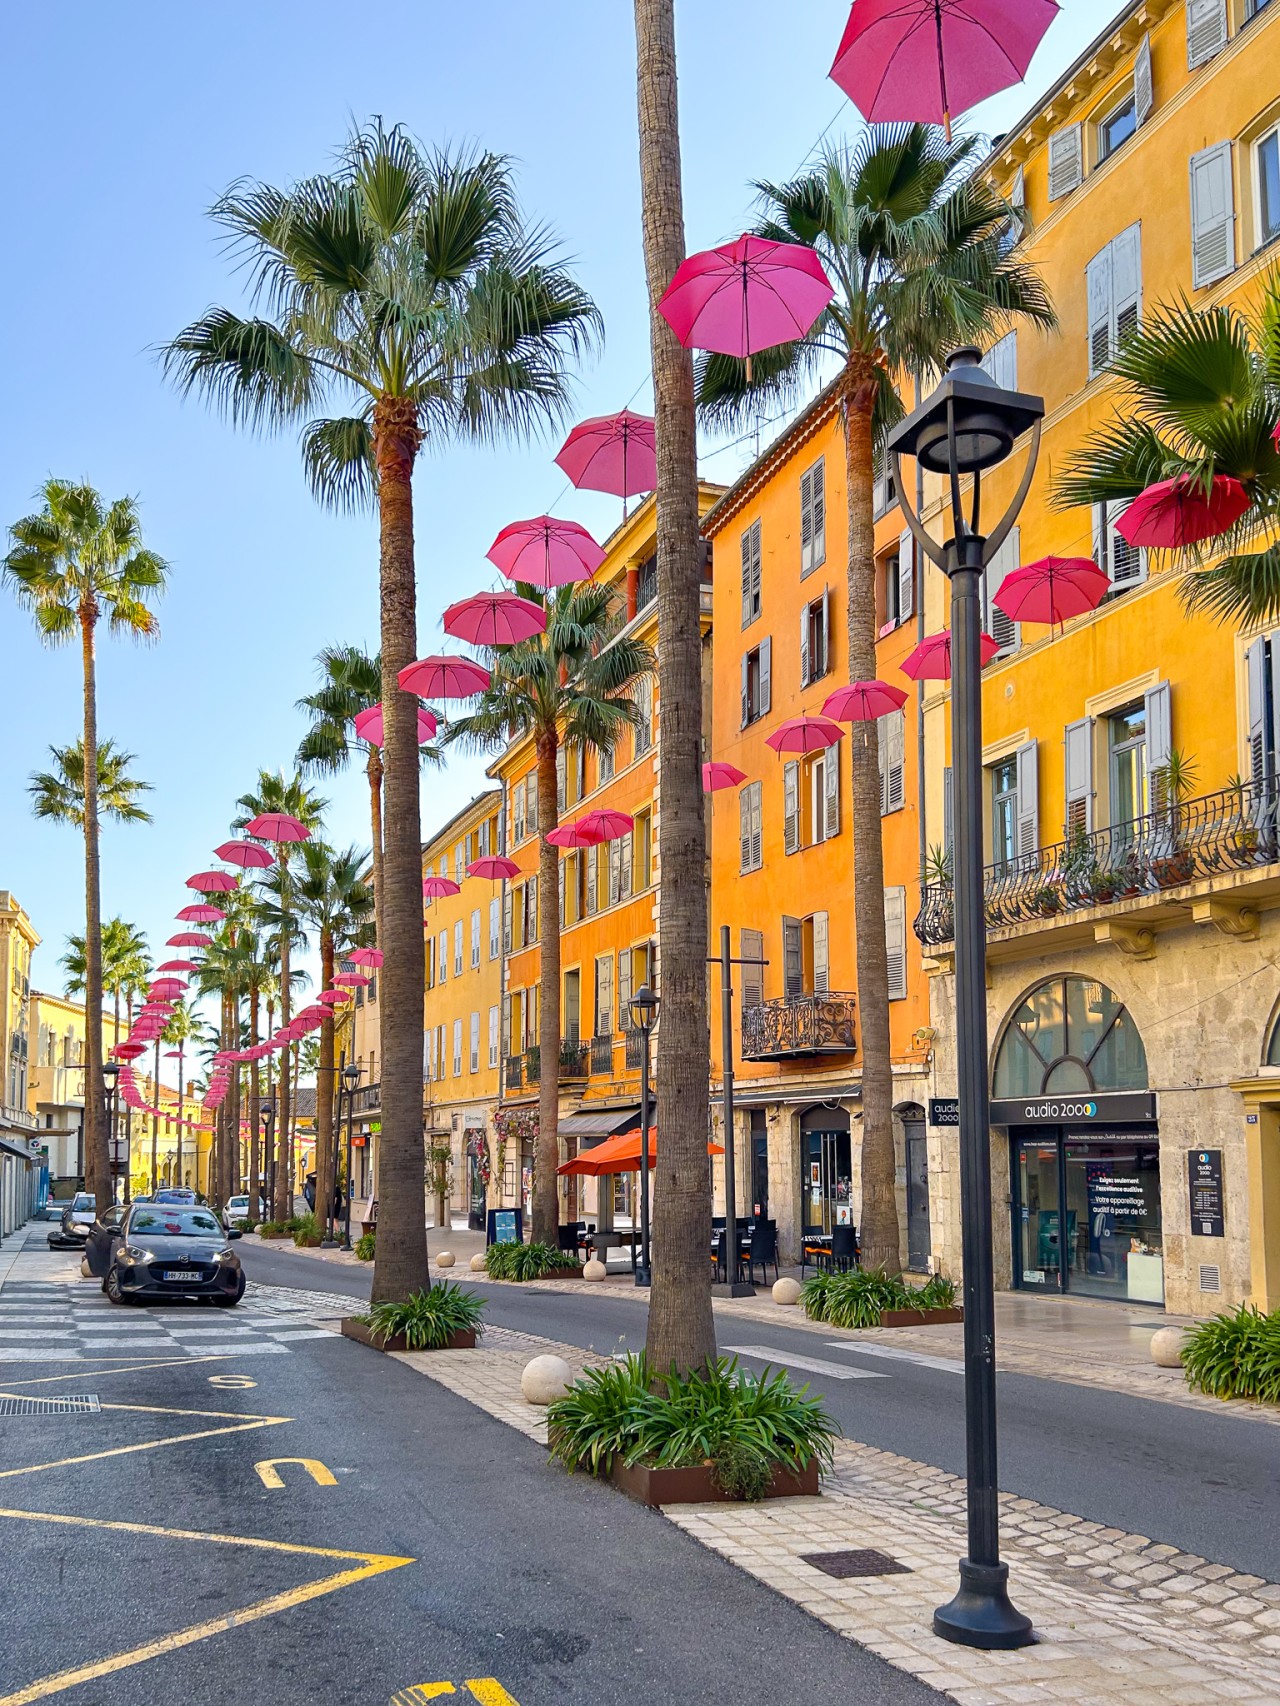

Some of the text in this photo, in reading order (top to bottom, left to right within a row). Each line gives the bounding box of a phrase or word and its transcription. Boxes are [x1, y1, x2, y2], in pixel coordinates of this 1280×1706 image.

[1024, 1102, 1092, 1118] audio 2000
[938, 1113, 959, 1122] 2000
[1095, 1196, 1144, 1207] Votre appareillage
[1115, 1207, 1129, 1215] partir
